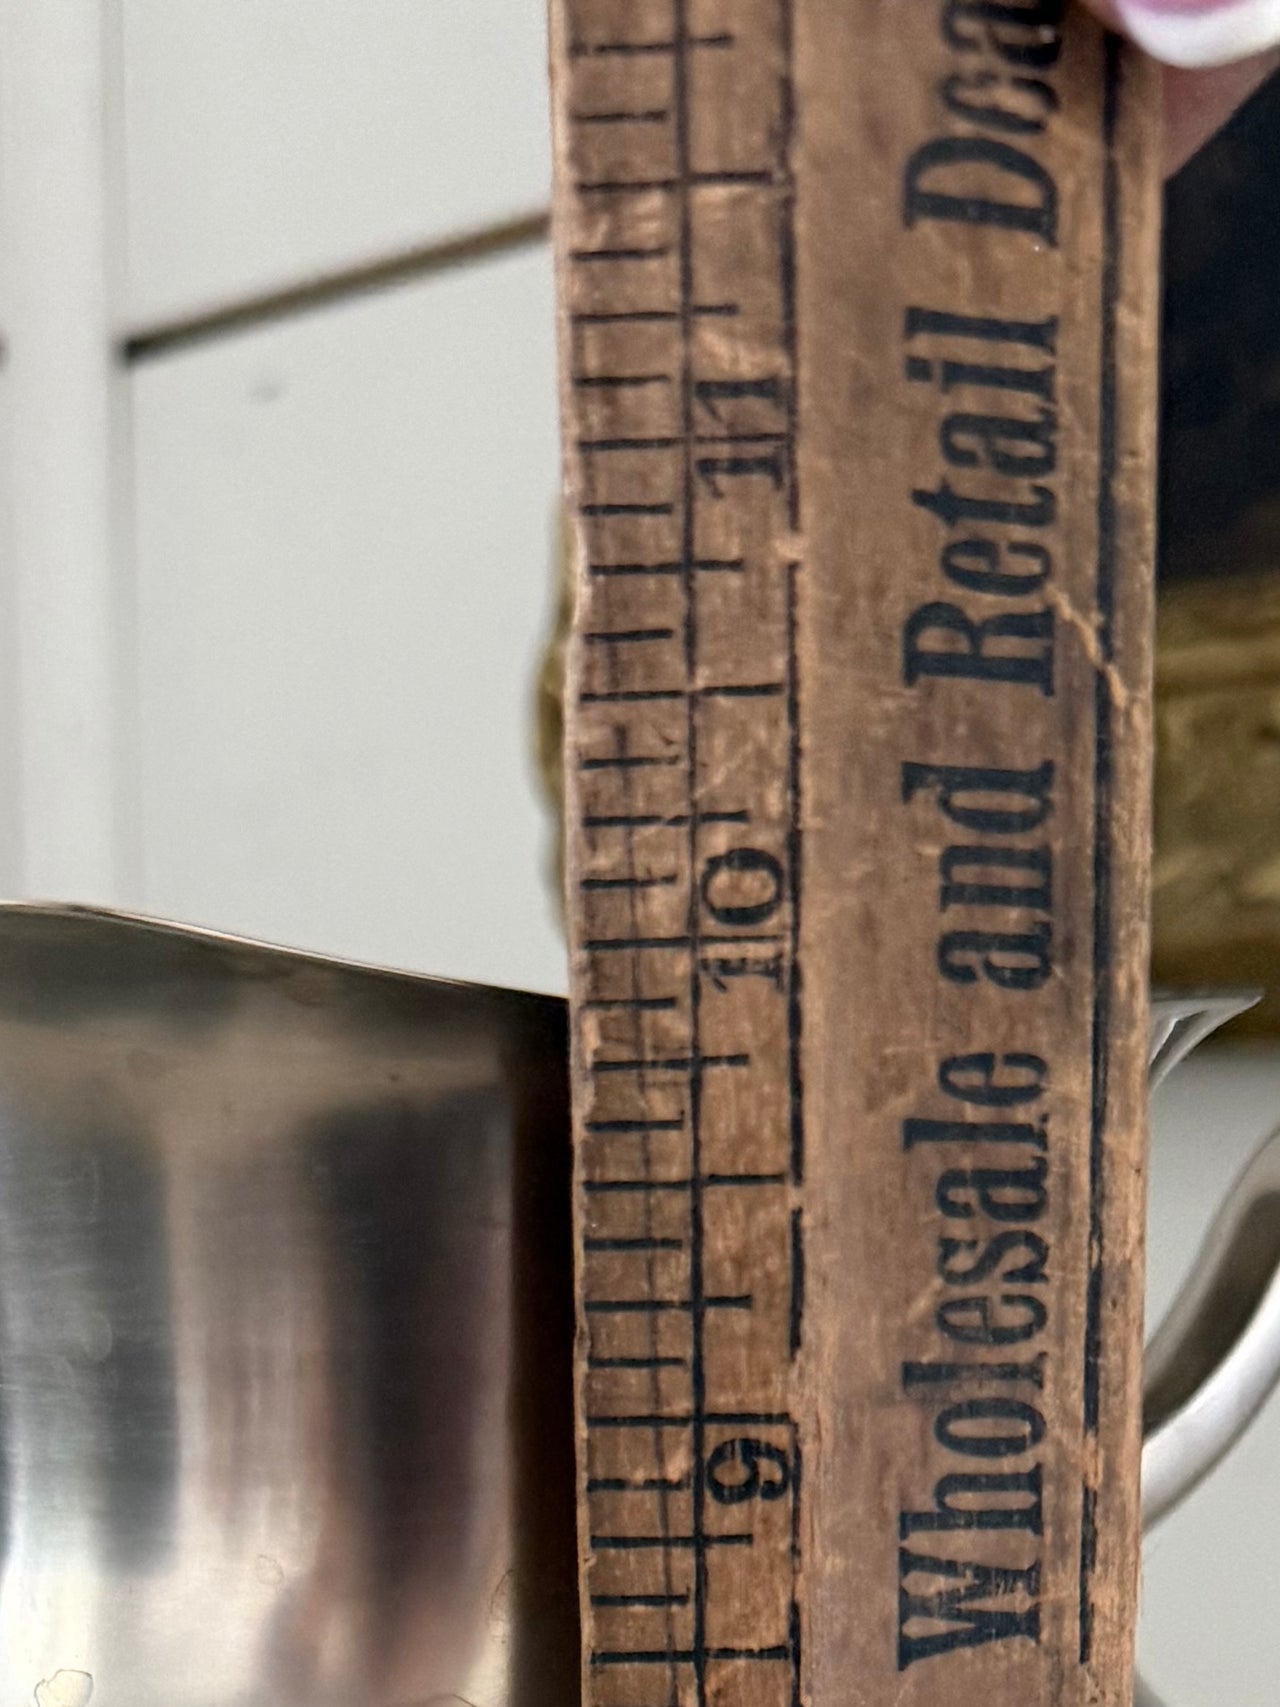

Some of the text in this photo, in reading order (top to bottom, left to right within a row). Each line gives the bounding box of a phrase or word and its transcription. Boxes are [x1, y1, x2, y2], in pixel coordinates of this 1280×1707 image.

[692, 374, 788, 502] 11
[904, 304, 1060, 700] Retail
[698, 846, 786, 994] 10
[900, 757, 1056, 992] and
[894, 1050, 1052, 1672] Wholesale
[706, 1436, 792, 1506] 9
